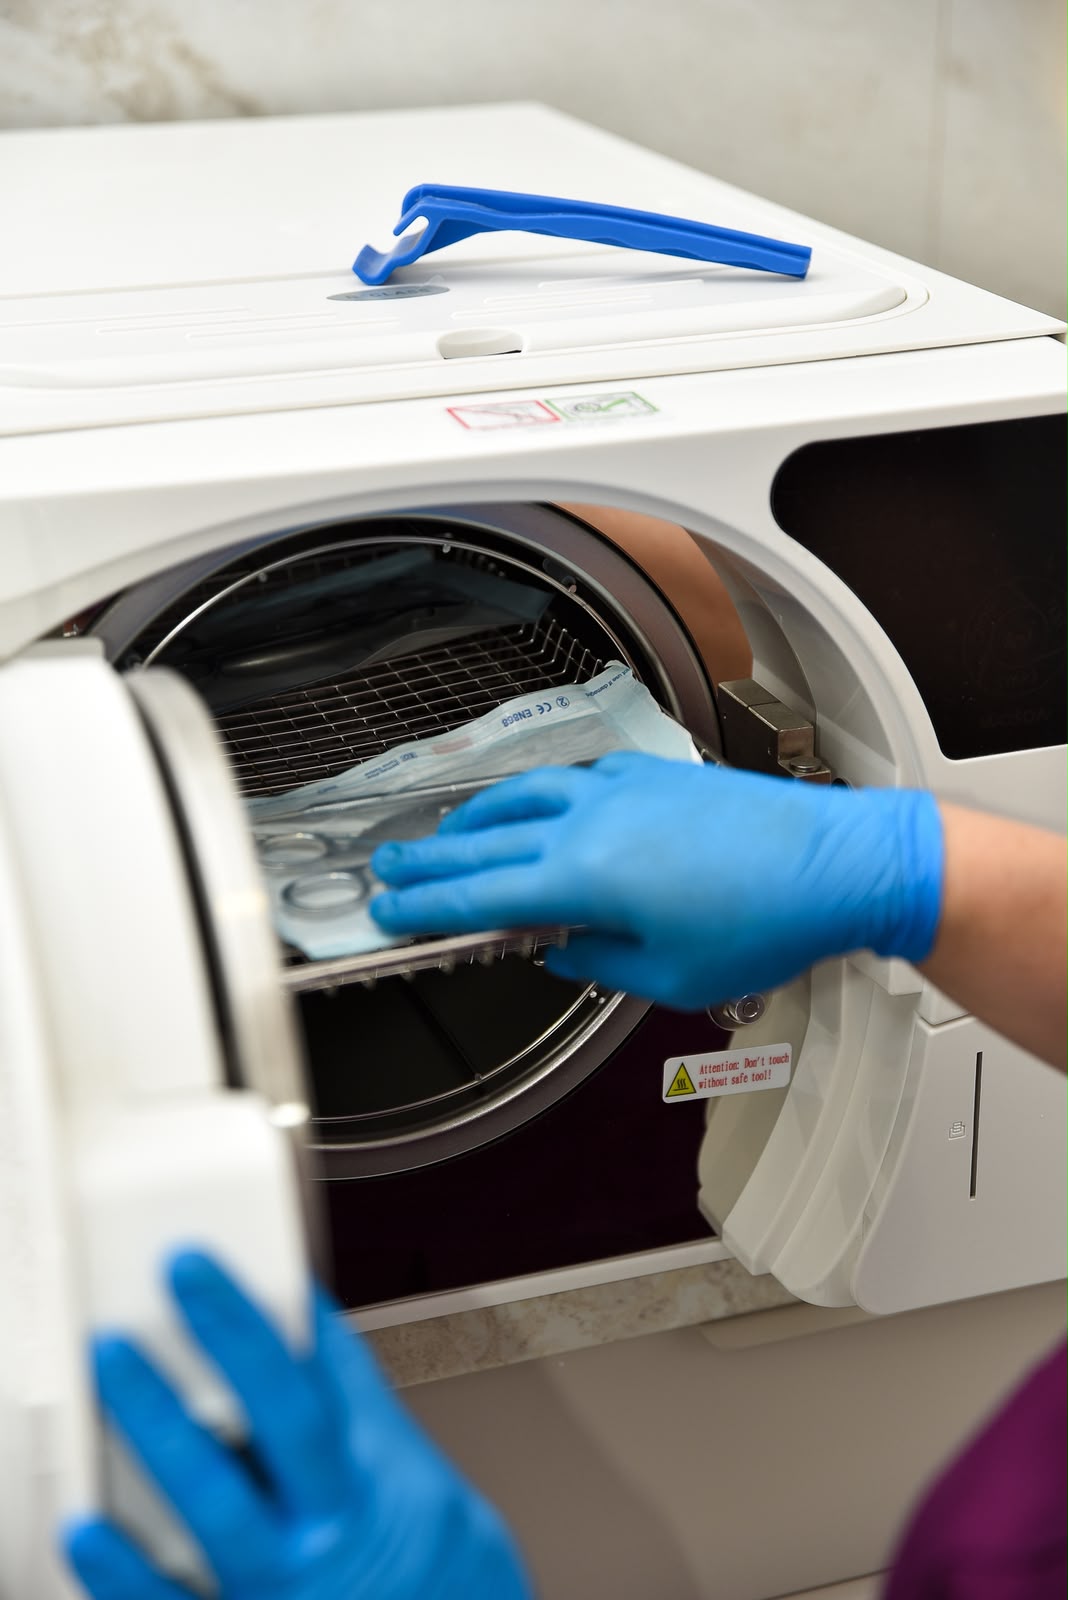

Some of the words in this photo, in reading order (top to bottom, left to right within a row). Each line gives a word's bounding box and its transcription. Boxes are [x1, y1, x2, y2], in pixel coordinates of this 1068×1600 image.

[501, 708, 533, 728] EN868
[699, 1061, 740, 1076] Attention:
[744, 1056, 766, 1069] Don't
[769, 1053, 790, 1066] touch
[698, 1076, 729, 1089] without
[731, 1073, 749, 1086] safe
[752, 1069, 772, 1083] tool!
